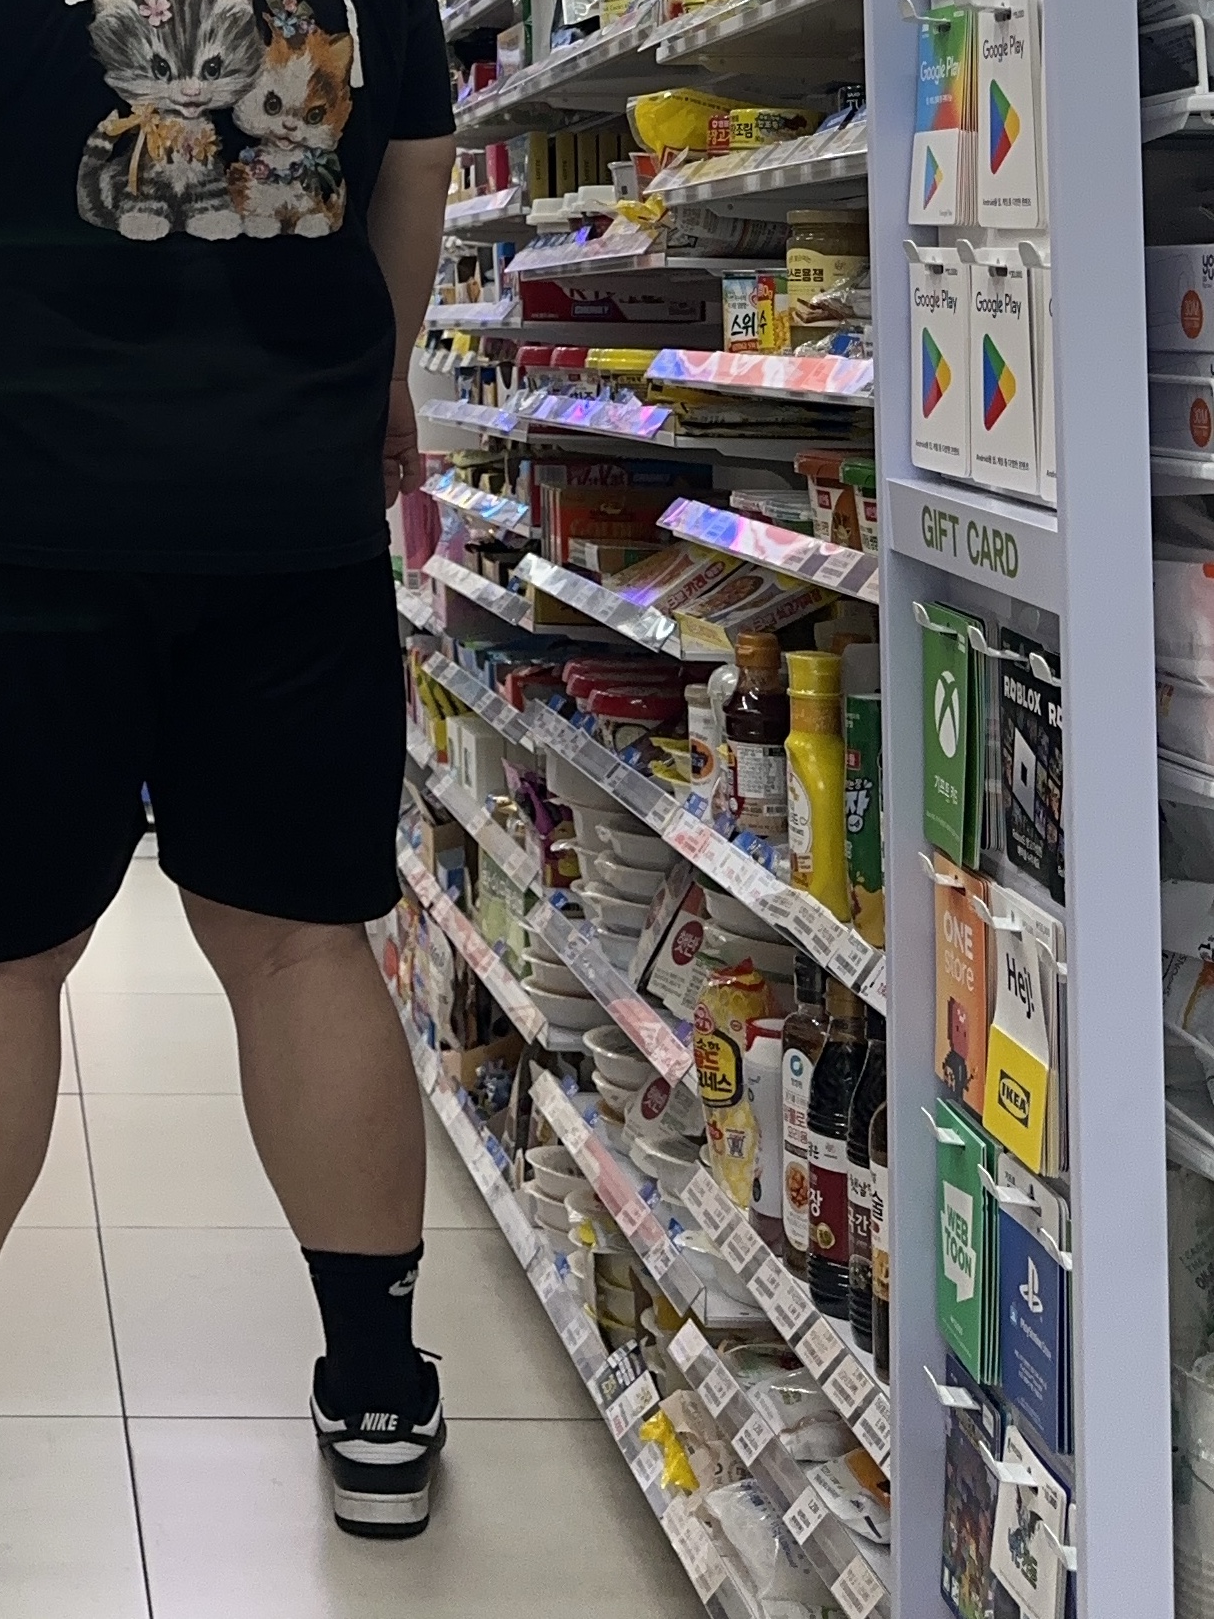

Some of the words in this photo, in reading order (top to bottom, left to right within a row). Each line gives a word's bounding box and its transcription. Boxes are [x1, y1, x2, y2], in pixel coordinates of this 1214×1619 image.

[982, 37, 1008, 63] Google
[1009, 35, 1025, 60] Play
[920, 58, 945, 85] Google
[945, 55, 960, 81] Play
[914, 287, 940, 313] Google
[940, 289, 958, 315] Play
[975, 290, 1003, 320] Google
[1004, 293, 1022, 320] Play
[921, 504, 960, 558] GIFT
[967, 519, 1019, 579] CARD
[1003, 675, 1042, 716] ROBLOX
[943, 911, 974, 961] ONE
[944, 949, 975, 992] store
[1005, 952, 1035, 1020] Hej!
[1001, 1082, 1028, 1115] IKEA
[947, 1204, 969, 1248] WEB
[944, 1226, 973, 1279] TOON
[360, 1412, 399, 1432] NIKE
